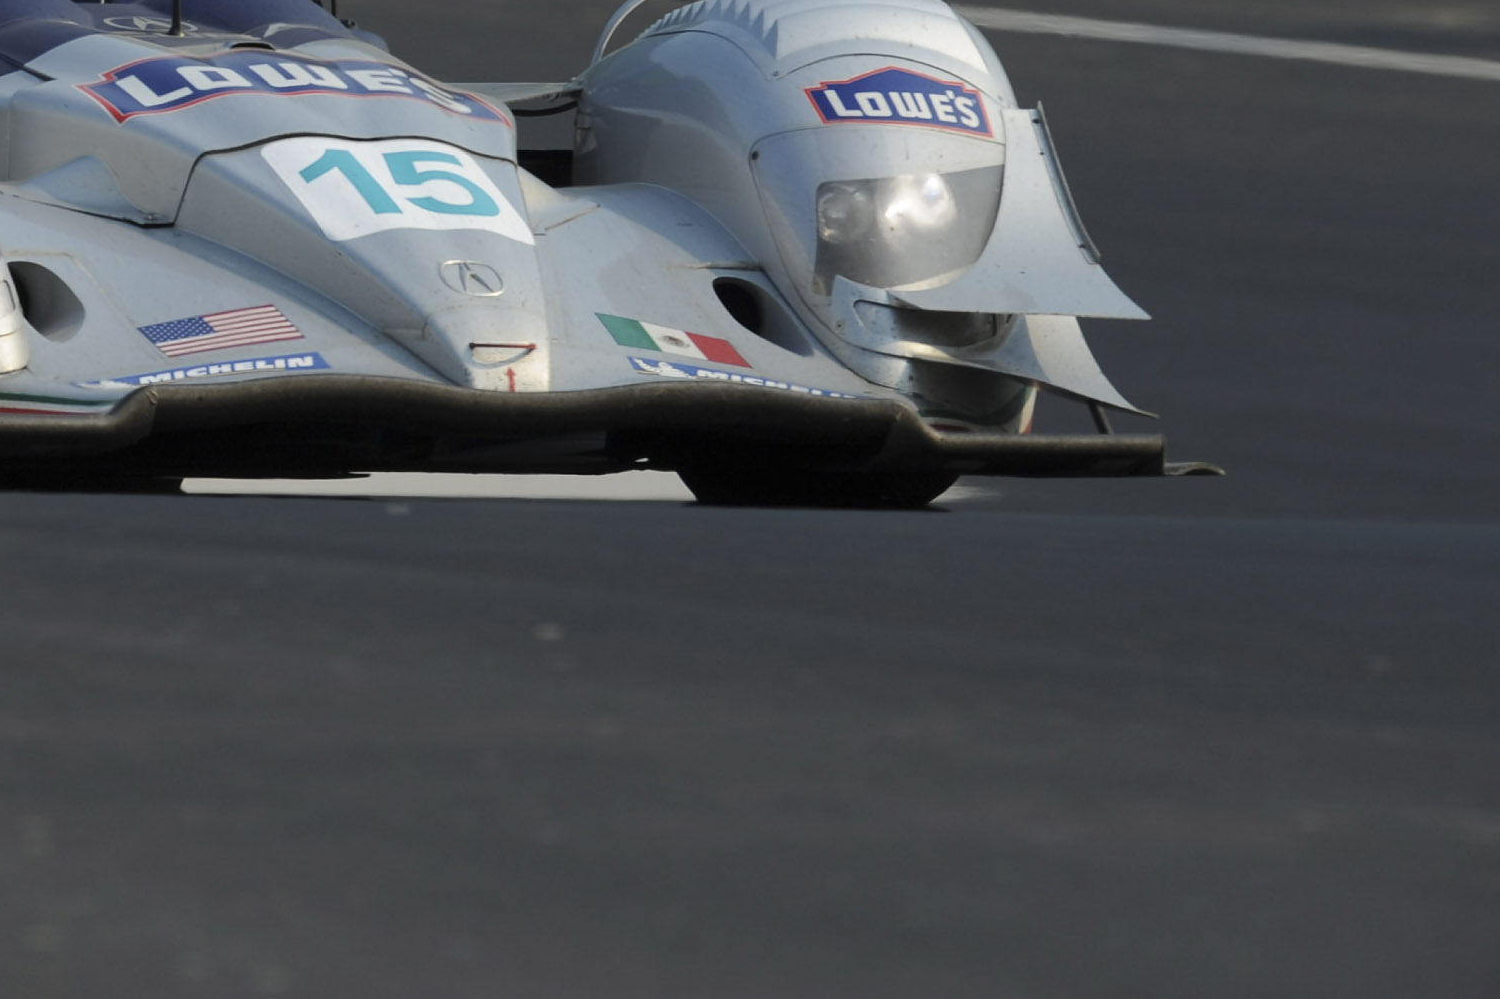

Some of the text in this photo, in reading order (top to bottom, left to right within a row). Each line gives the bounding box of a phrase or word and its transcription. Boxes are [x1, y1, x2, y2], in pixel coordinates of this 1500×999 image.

[115, 63, 472, 114] LOWE'S
[824, 90, 980, 128] LOWE'S
[299, 148, 500, 217] 15
[139, 356, 314, 385] MICHELIN
